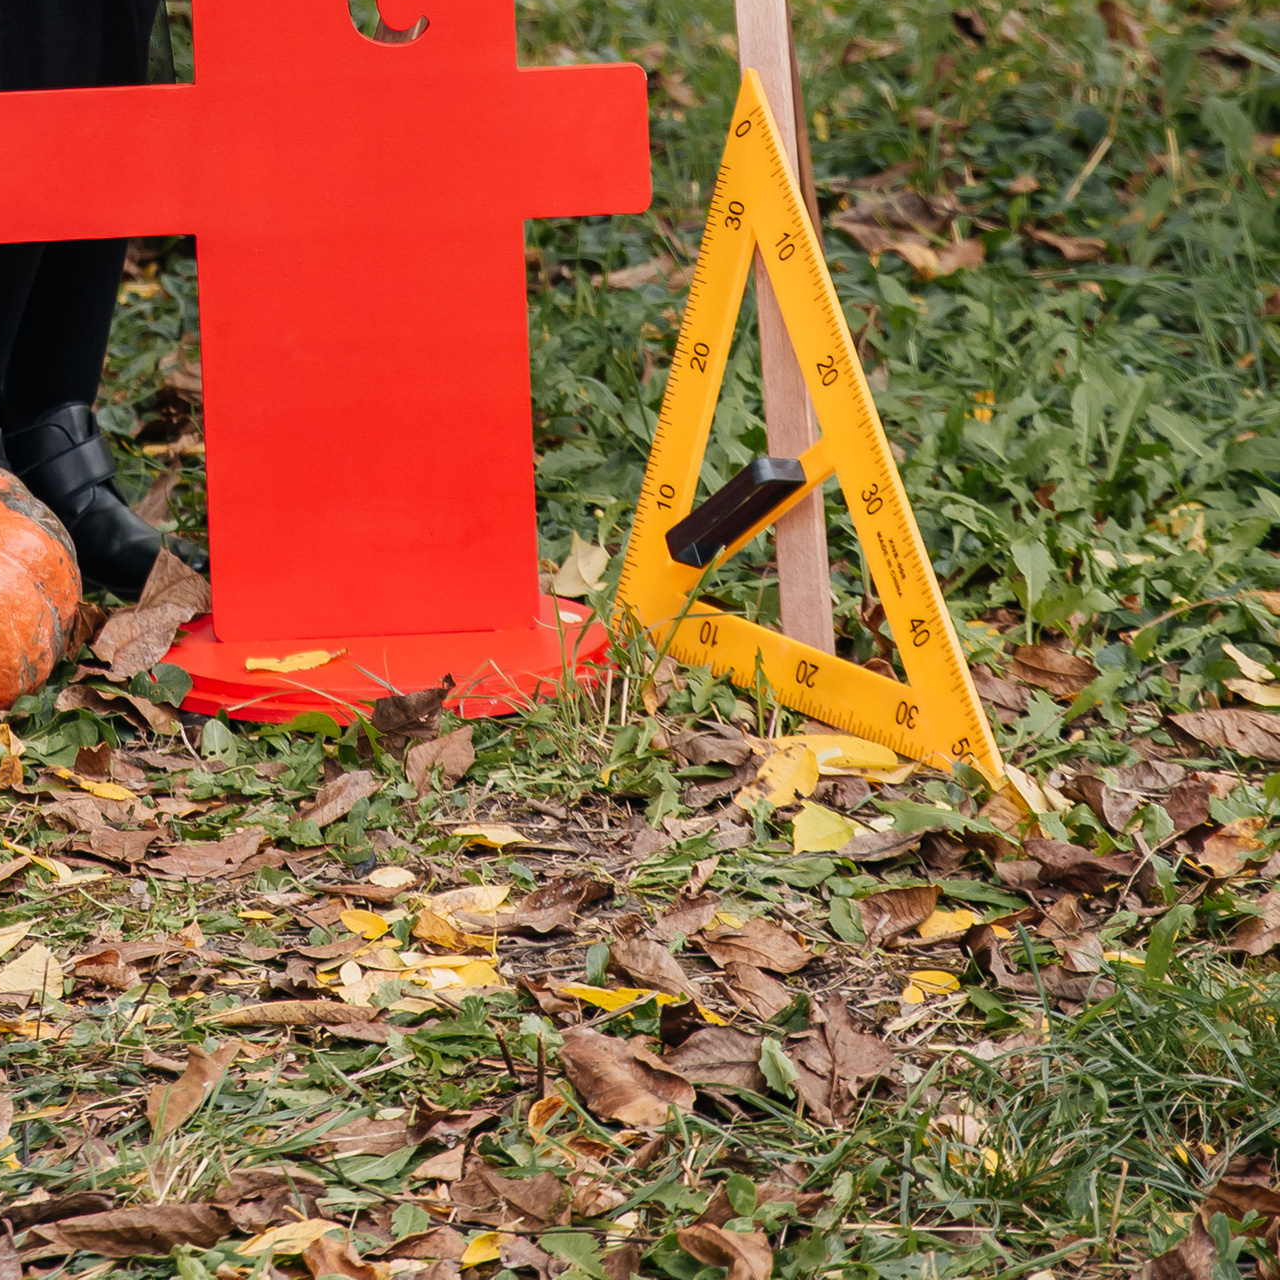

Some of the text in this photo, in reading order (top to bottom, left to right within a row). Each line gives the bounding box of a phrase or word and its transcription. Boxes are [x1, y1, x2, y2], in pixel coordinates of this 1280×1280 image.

[734, 119, 753, 138] 0
[724, 200, 745, 231] 30
[775, 231, 796, 262] 10
[690, 342, 711, 374] 20
[816, 355, 839, 387] 20
[656, 483, 676, 511] 10
[861, 483, 883, 515] 30
[877, 531, 888, 558] MADE
[890, 570, 903, 598] CHINA
[699, 621, 719, 648] 10
[909, 618, 930, 647] 40
[795, 660, 819, 688] 20
[895, 701, 919, 730] 30
